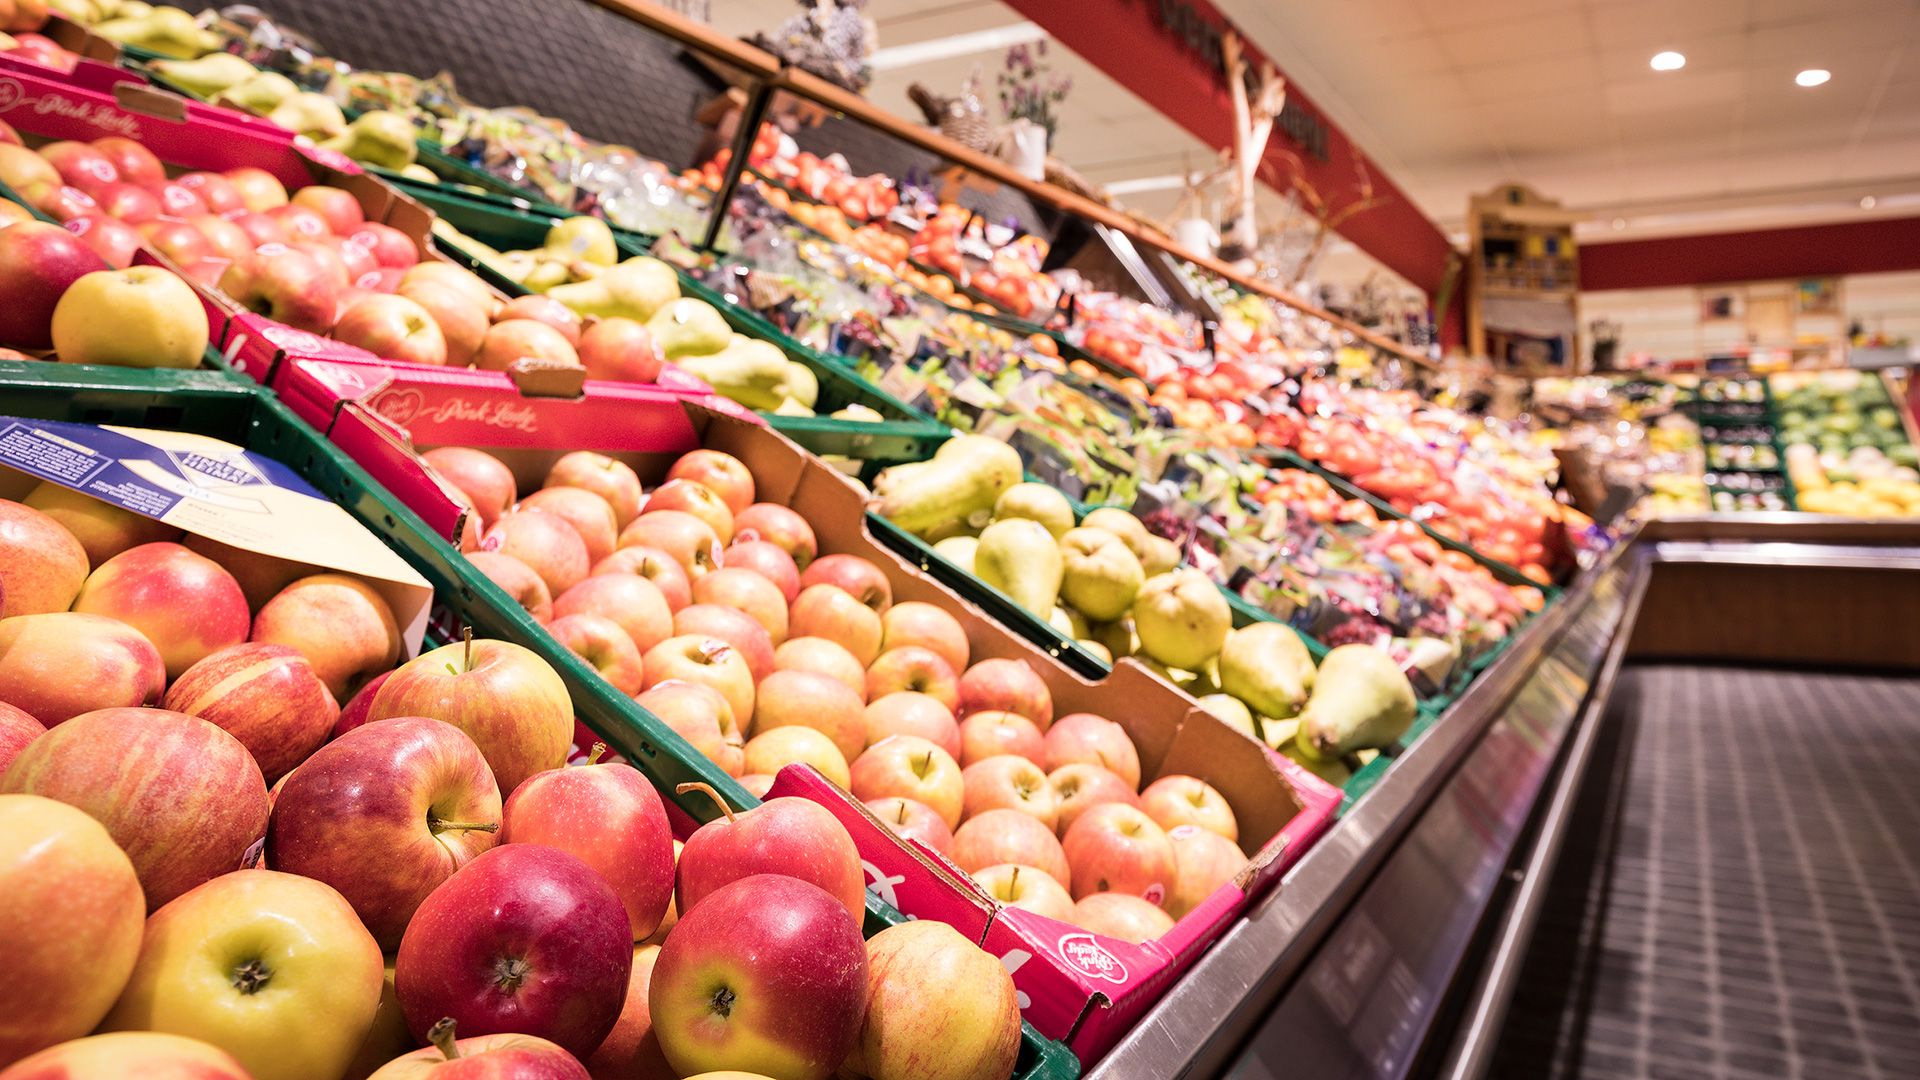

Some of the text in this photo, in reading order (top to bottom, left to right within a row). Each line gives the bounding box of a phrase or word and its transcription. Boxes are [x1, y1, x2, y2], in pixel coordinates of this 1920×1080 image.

[433, 398, 538, 433] Pink Lady
[181, 459, 248, 485] HEIMAT
[1066, 942, 1101, 959] Lady
[1078, 952, 1115, 971] Pink
